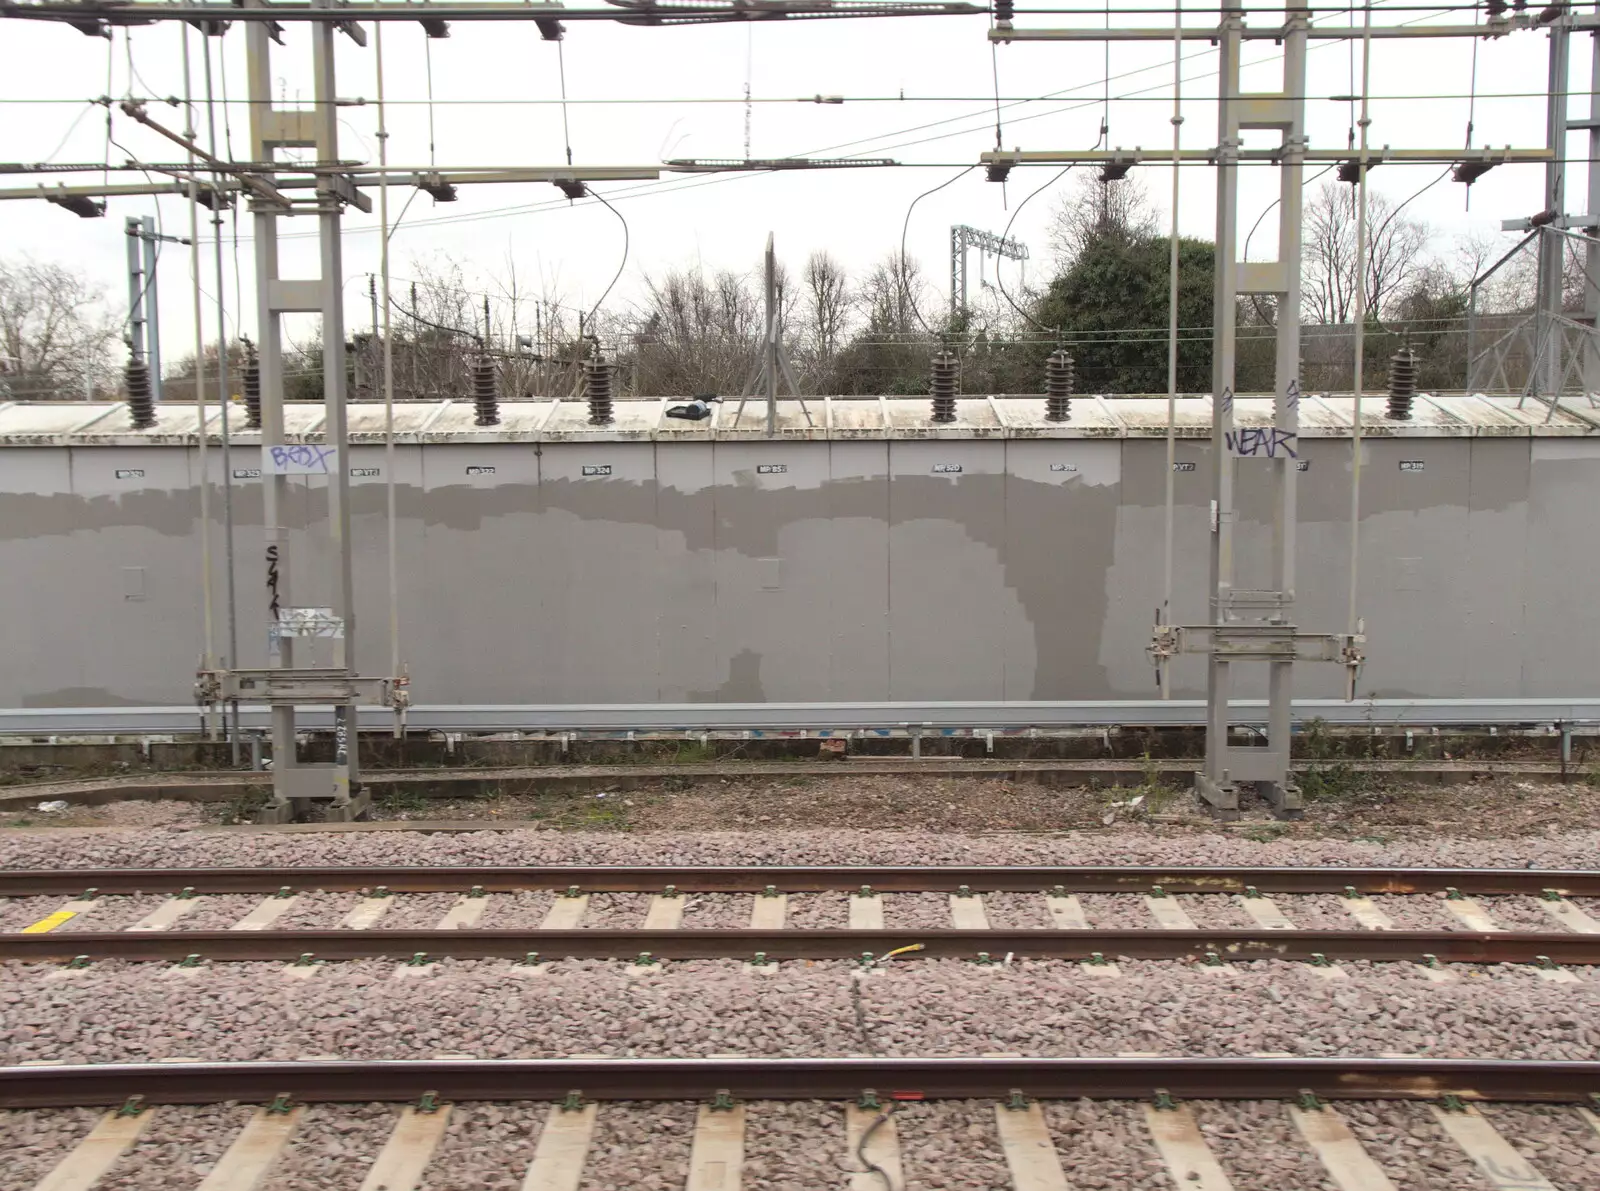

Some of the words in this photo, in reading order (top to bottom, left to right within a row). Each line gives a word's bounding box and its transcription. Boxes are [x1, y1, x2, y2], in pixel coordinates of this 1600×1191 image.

[1225, 427, 1296, 457] WEAR
[584, 466, 596, 474] MP
[597, 466, 610, 474] 324
[934, 464, 945, 472] MP
